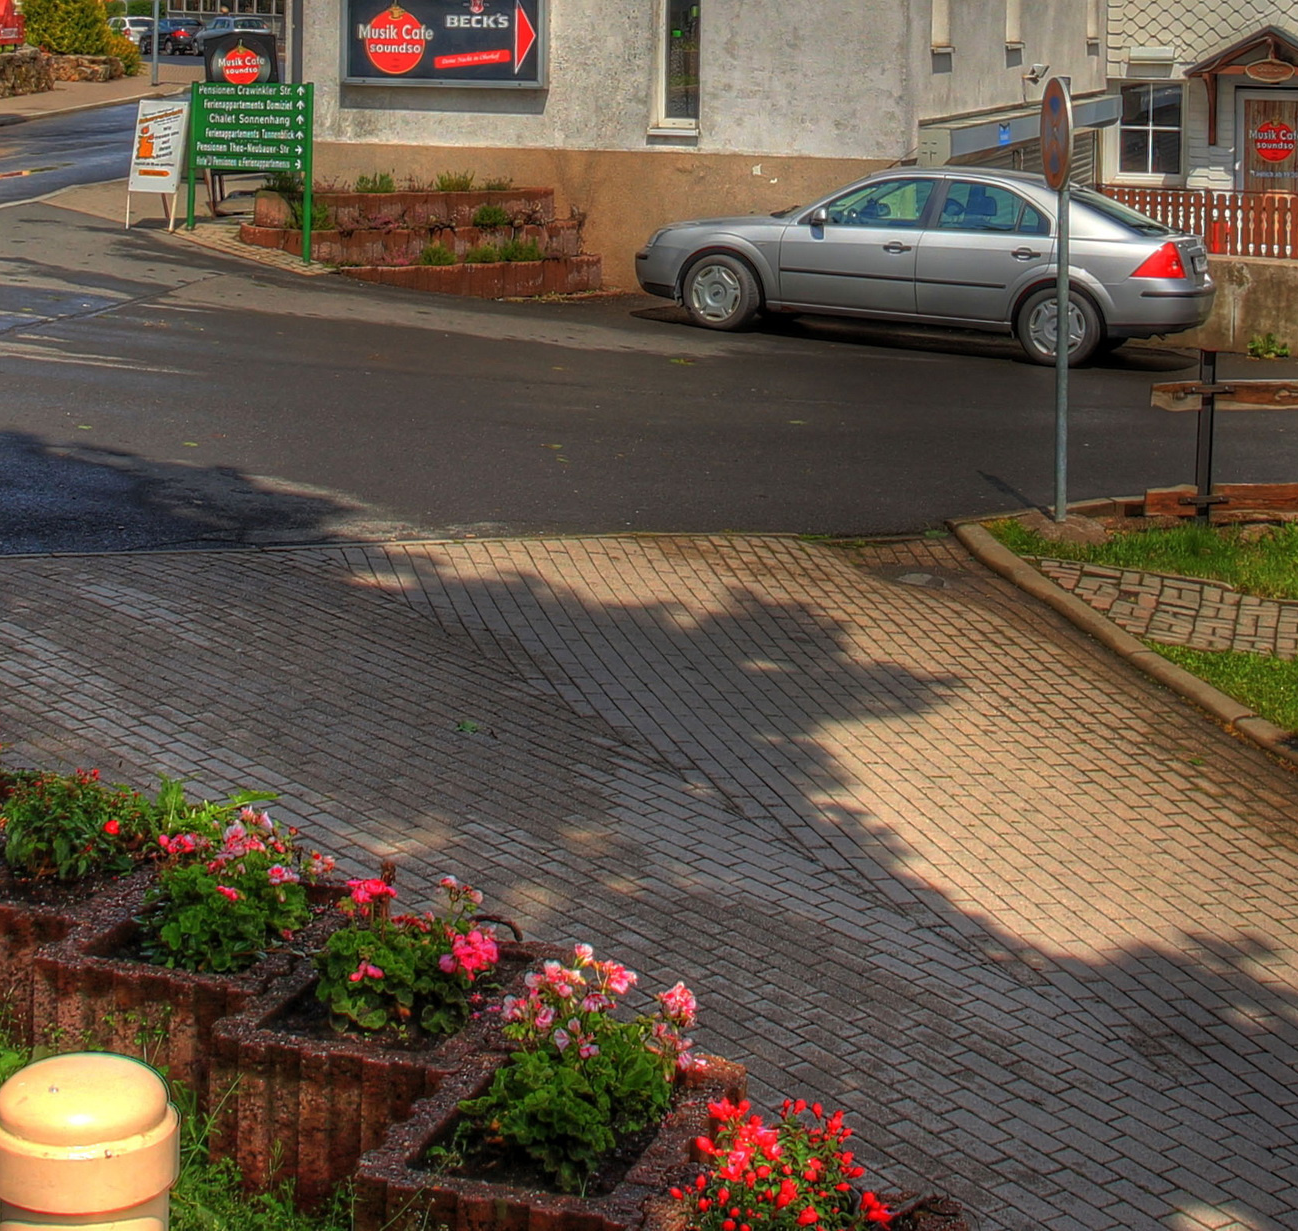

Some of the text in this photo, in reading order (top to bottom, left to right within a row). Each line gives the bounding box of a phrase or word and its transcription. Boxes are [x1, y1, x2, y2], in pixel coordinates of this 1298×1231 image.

[357, 24, 434, 40] Musik Cafe
[370, 43, 421, 54] soundso
[218, 55, 265, 67] Musik Cafe
[225, 67, 258, 75] soundso
[199, 85, 293, 95] Pensionen Crawinkler Str.
[204, 99, 264, 111] Ferienappartements
[209, 113, 290, 127] Chalet Sonnenhang
[1249, 129, 1277, 140] Musik
[196, 141, 227, 151] Pensionen
[1256, 141, 1294, 149] soundso
